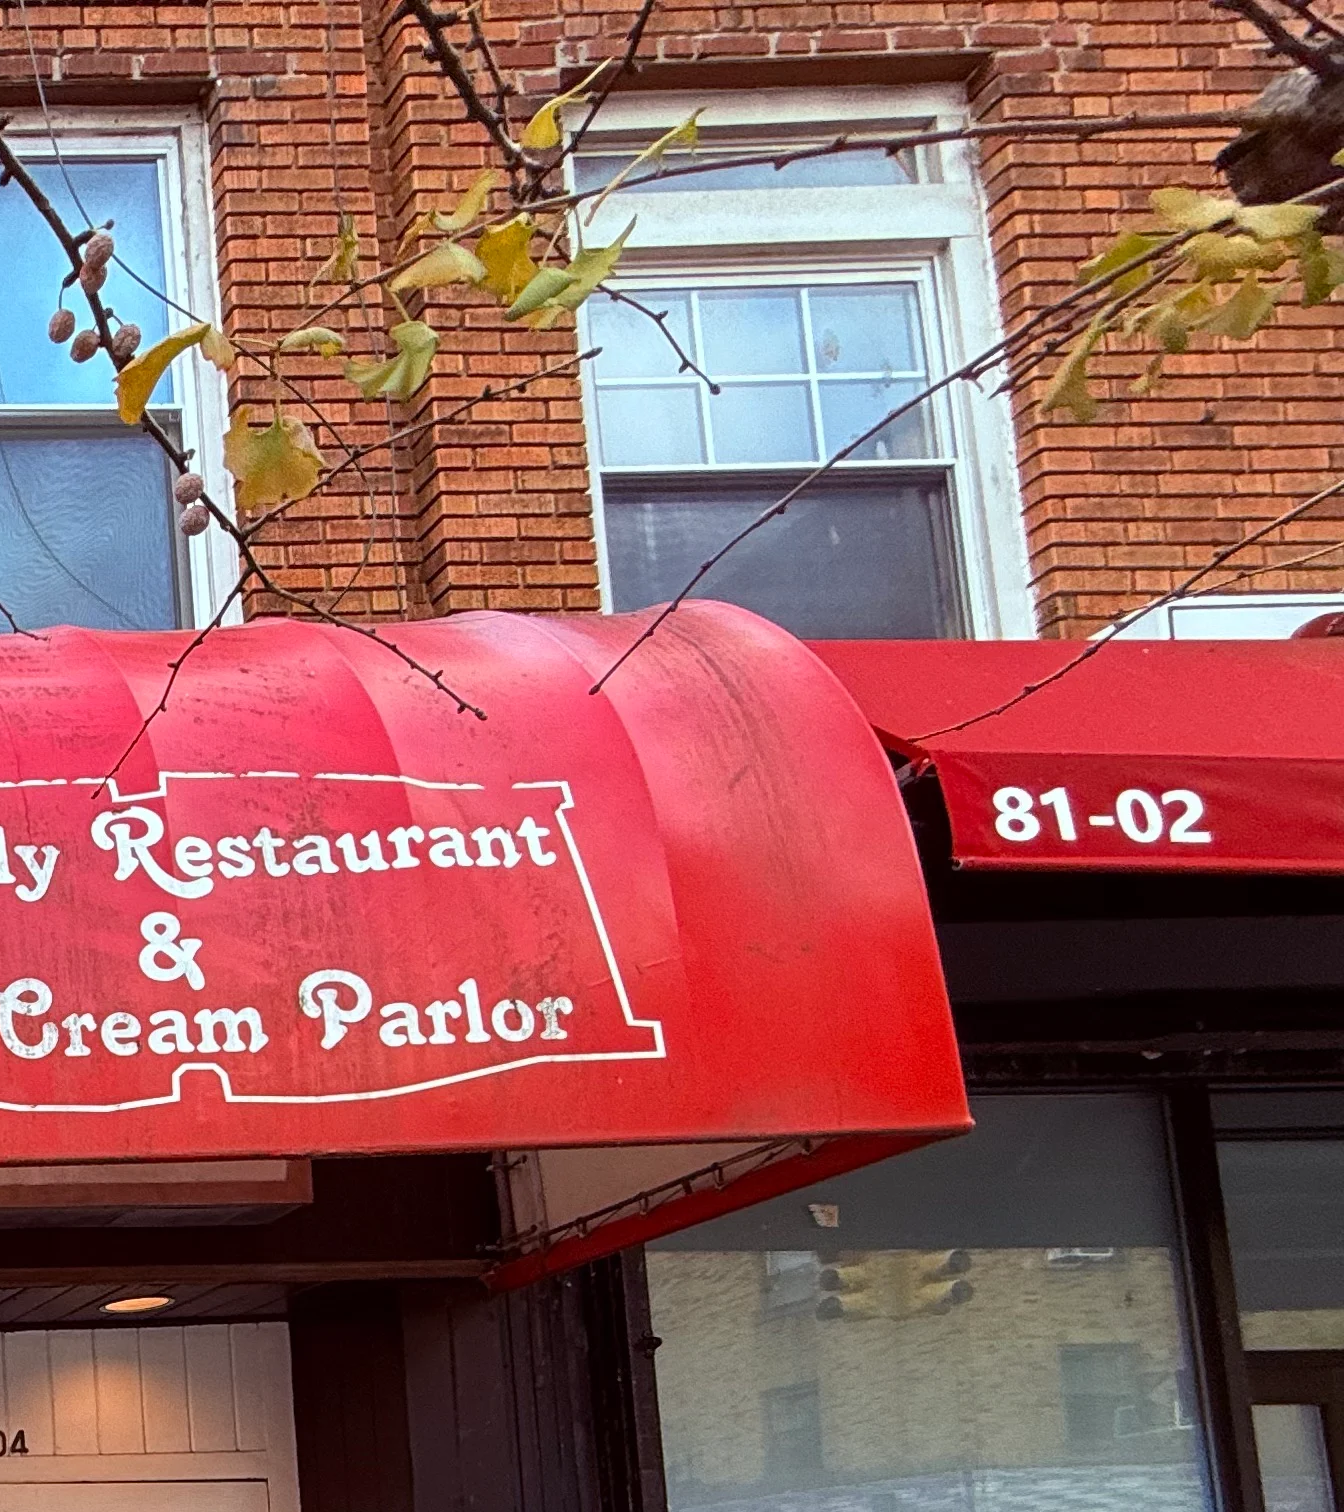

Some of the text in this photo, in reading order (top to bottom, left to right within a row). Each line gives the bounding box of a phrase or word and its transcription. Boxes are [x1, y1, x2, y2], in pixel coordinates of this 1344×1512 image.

[92, 806, 557, 900] Restaurant
[992, 786, 1211, 844] 81-02
[140, 912, 204, 990] &
[300, 969, 573, 1051] Parlor
